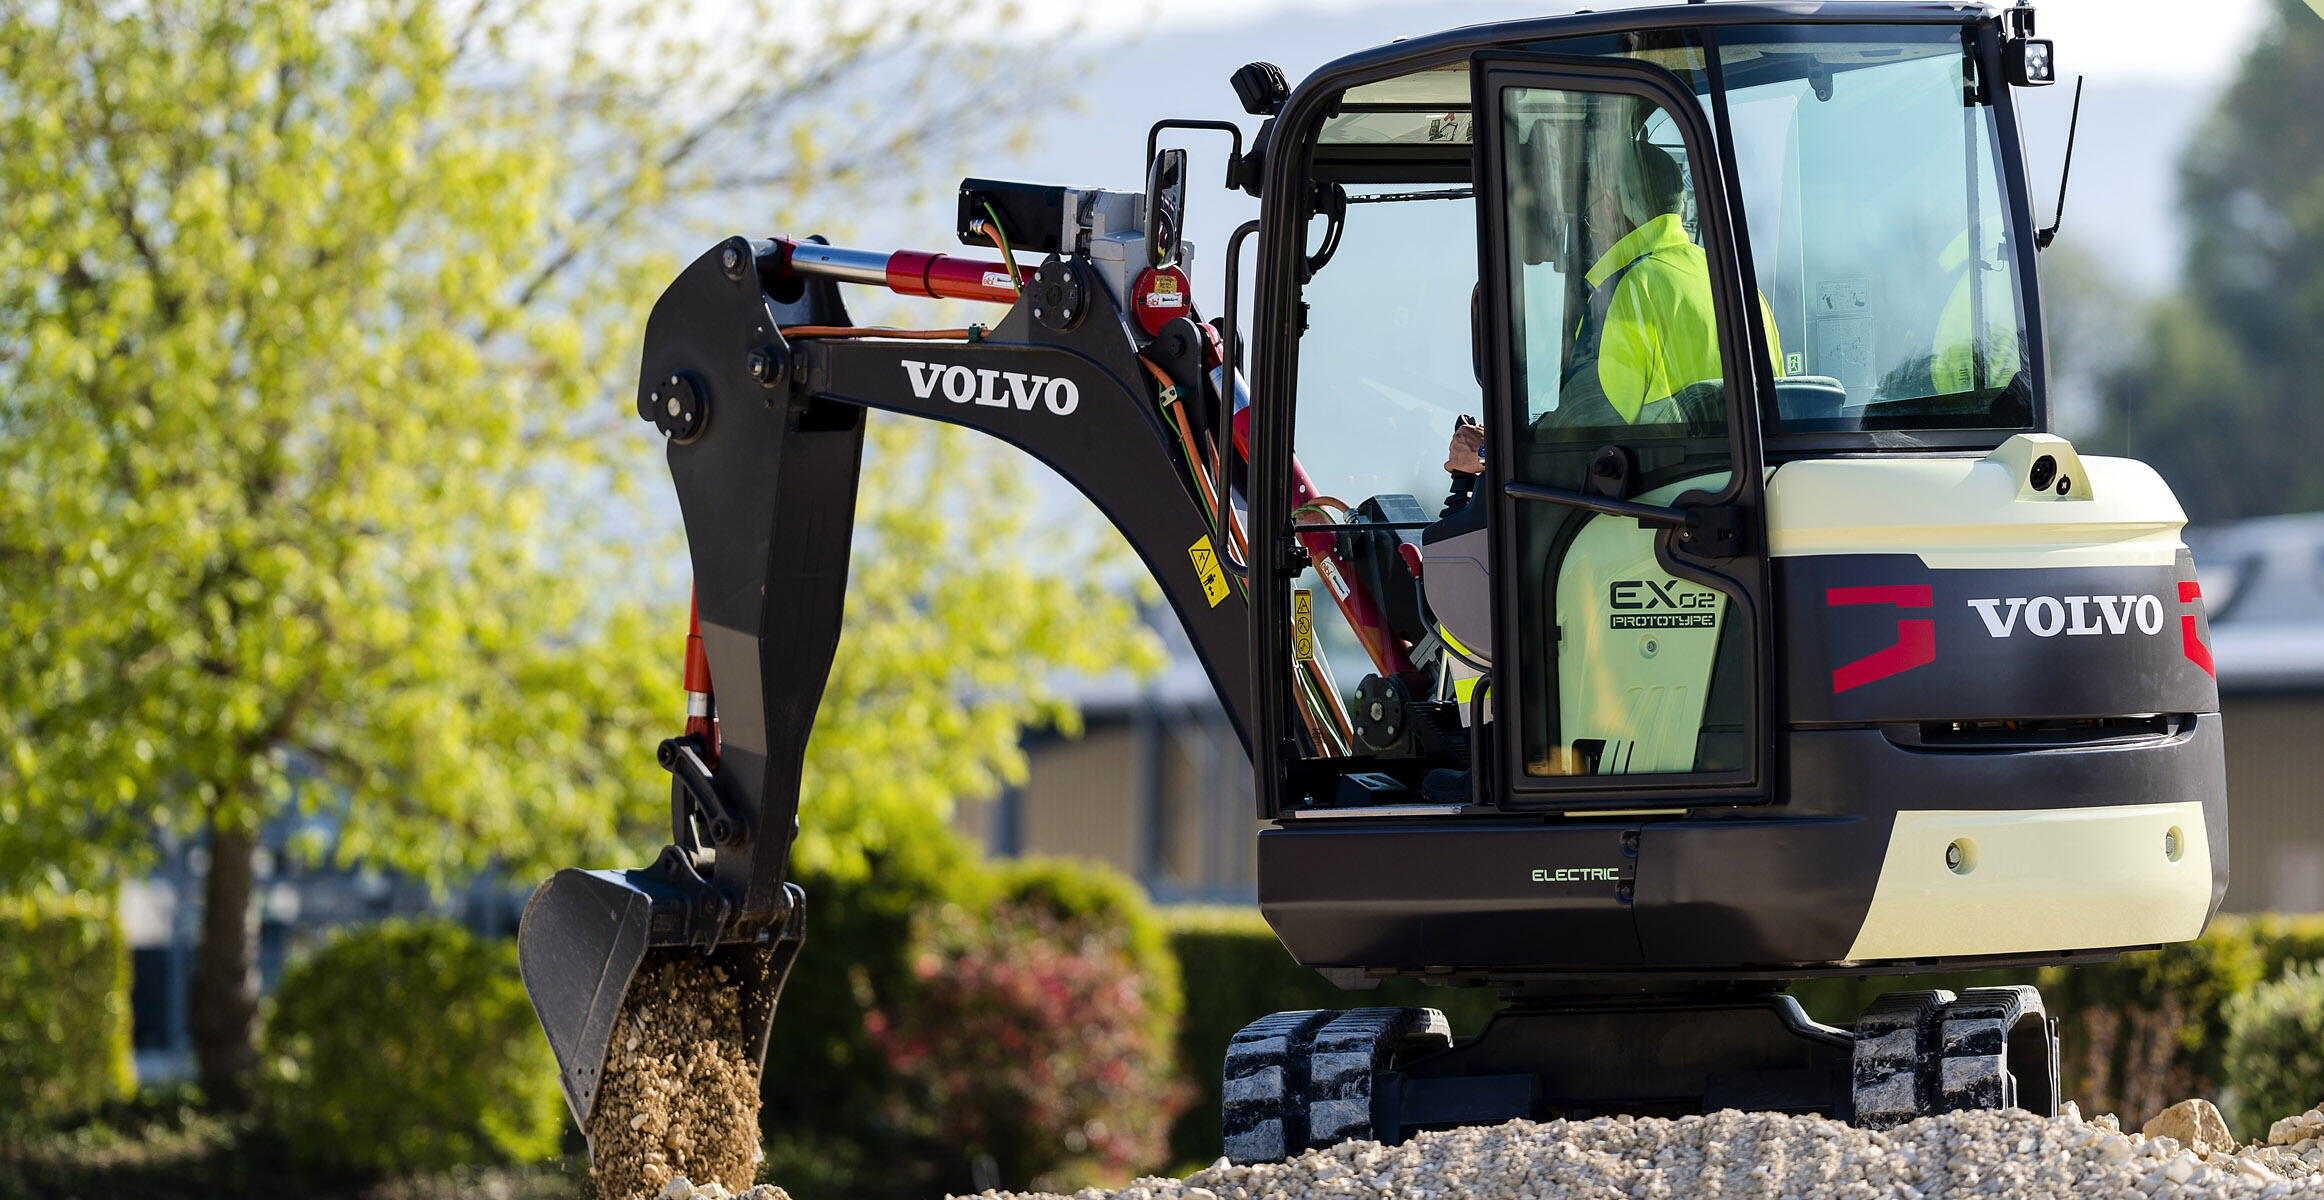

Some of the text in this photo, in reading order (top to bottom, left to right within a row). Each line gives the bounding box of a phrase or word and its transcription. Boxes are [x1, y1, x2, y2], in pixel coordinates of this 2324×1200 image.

[901, 360, 1080, 416] VOLVO
[1610, 580, 1716, 609] EX02
[1611, 614, 1714, 628] PROTOTYPE
[1967, 594, 2165, 638] VOLVO
[1531, 867, 1620, 882] ELECTRIC
